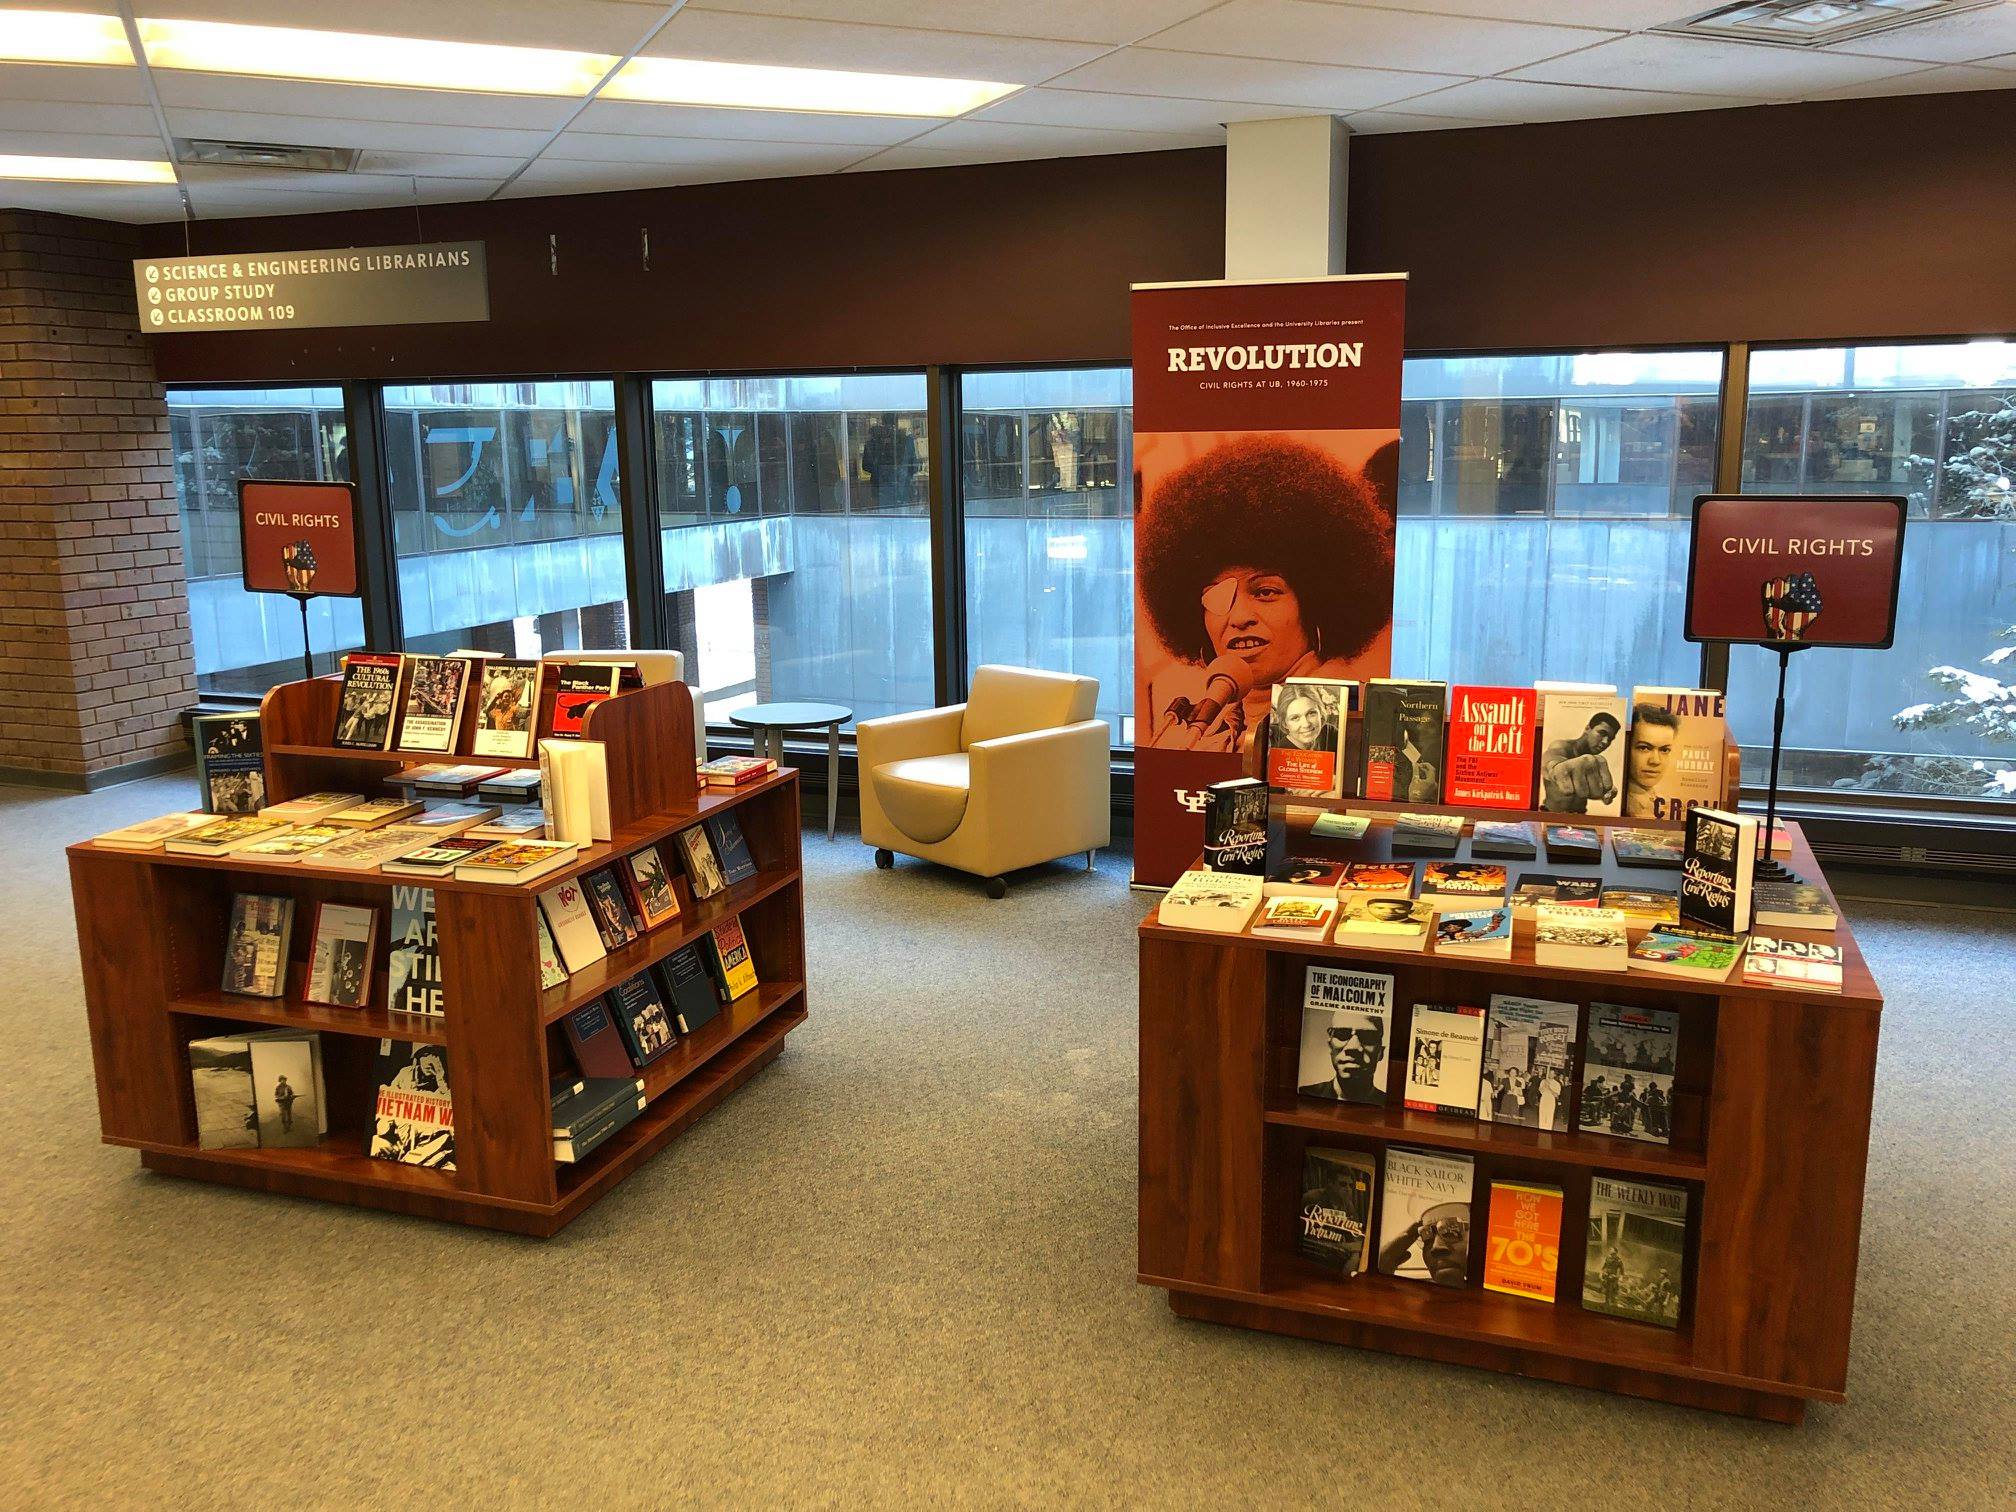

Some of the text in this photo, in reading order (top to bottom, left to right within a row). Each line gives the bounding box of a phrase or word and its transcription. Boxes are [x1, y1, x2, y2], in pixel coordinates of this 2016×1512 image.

[162, 250, 471, 281] SCIENCE & ENGINEERING LIBRARIANS
[166, 284, 275, 302] GROUP STUDY
[168, 305, 295, 323] CLASSROOM 109
[1231, 322, 1260, 330] Excellence
[1285, 320, 1313, 328] University
[1341, 319, 1364, 327] present
[1168, 342, 1364, 372] REVOLUTION
[1199, 381, 1221, 390] CIVIL
[1223, 380, 1253, 389] RIGHTS
[1256, 380, 1267, 388] AT
[1286, 379, 1328, 388] 1960-1975
[255, 512, 340, 528] CIVIL RIGHTS
[1722, 537, 1874, 556] CIVIL RIGHTS
[352, 673, 391, 682] CULTURAL
[356, 666, 371, 674] THE
[347, 680, 394, 690] REVOLUTION
[1400, 700, 1439, 710] Northern
[1458, 694, 1526, 726] Assault
[1664, 693, 1725, 718] JANE
[1399, 713, 1431, 723] Passage
[1473, 724, 1486, 736] on
[1468, 724, 1523, 754] the Left
[1682, 749, 1710, 760] PAULI
[1676, 759, 1715, 771] MURRAY
[1218, 829, 1267, 846] Reporting
[1685, 857, 1732, 891] Reporting
[1556, 880, 1598, 888] WARS
[392, 884, 436, 913] WE
[1312, 972, 1387, 991] THE ICONOGRAPHY
[1310, 985, 1386, 1007] OF MALCOLM X
[1310, 1001, 1385, 1014] GRAEME ABERNETHY
[1415, 1027, 1479, 1042] Simone de Beauvoir
[387, 1090, 425, 1104] ILLUSTRATED
[1387, 1160, 1421, 1176] BLACK
[1425, 1167, 1467, 1184] SAILOR,
[1385, 1172, 1423, 1189] WHITE
[1426, 1179, 1456, 1195] NAVY
[1596, 1181, 1681, 1210] THE WEEKLY WAR
[1521, 1201, 1536, 1211] WE
[1515, 1210, 1539, 1221] GOT
[1491, 1236, 1558, 1272] 70'S
